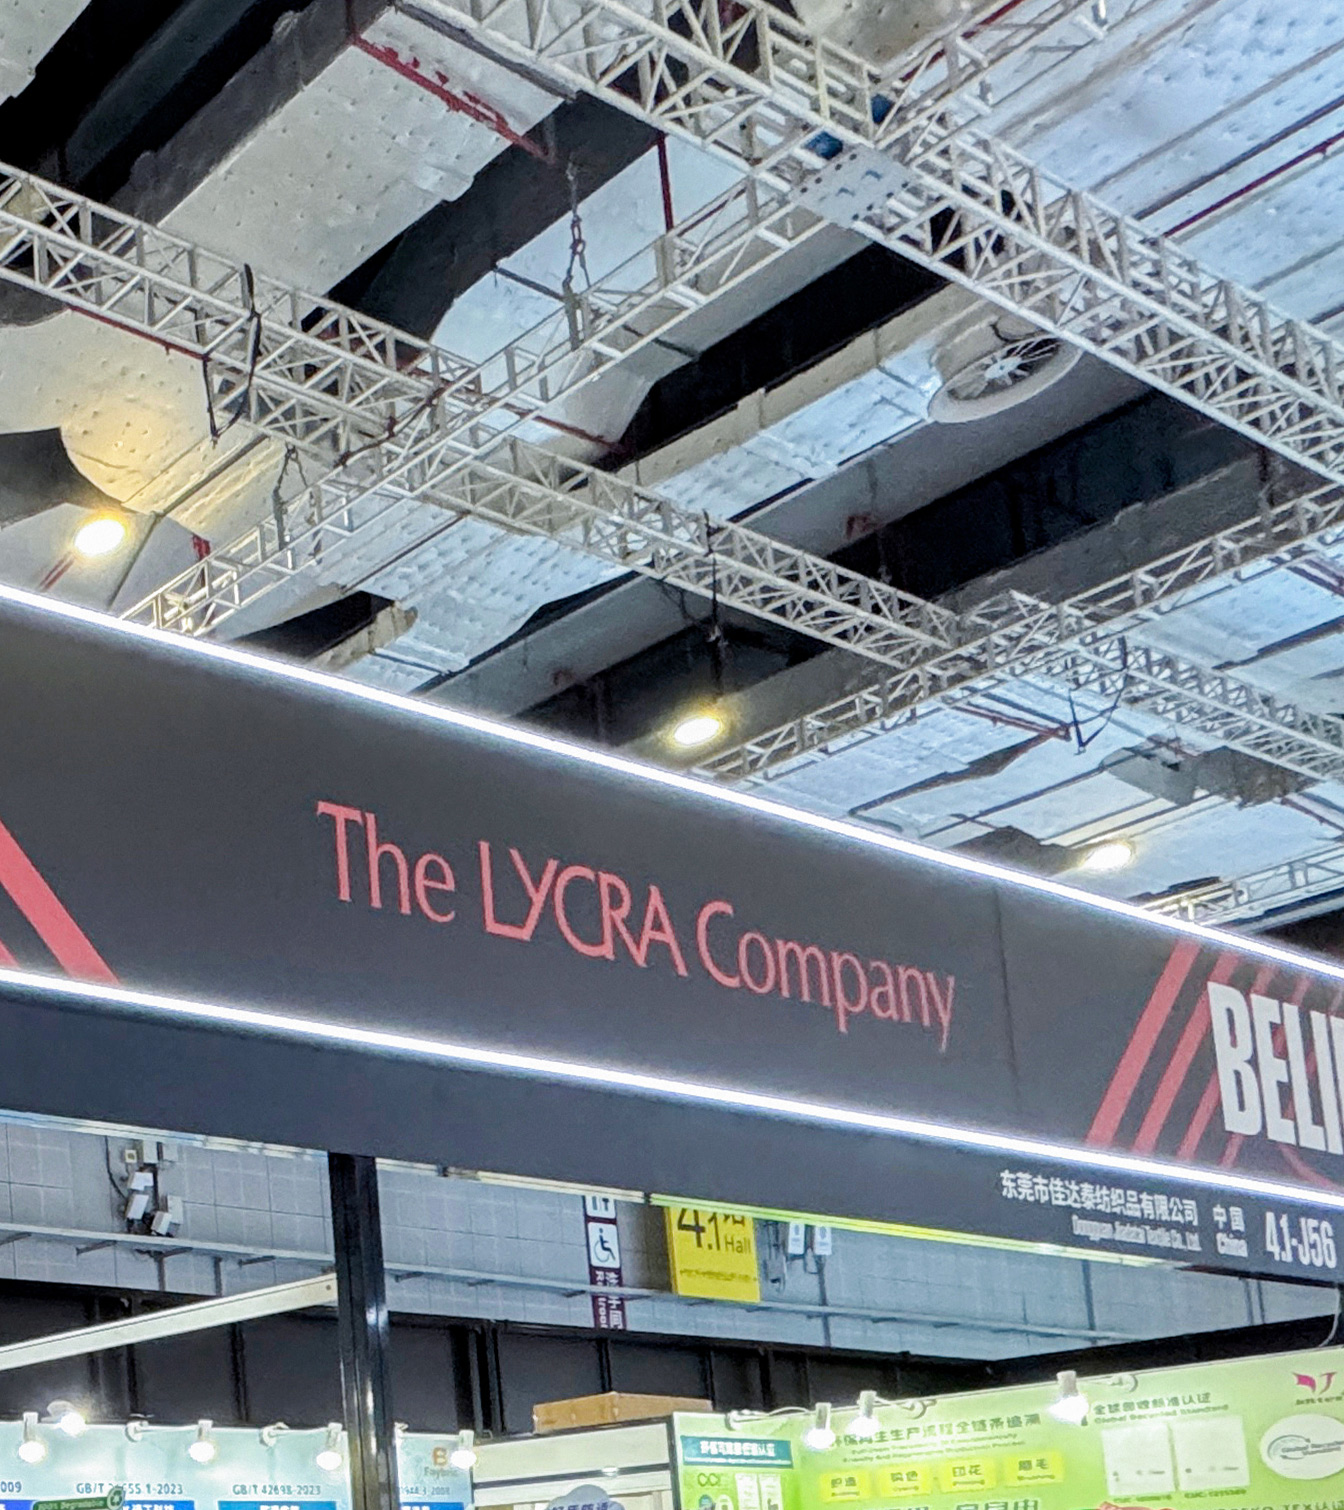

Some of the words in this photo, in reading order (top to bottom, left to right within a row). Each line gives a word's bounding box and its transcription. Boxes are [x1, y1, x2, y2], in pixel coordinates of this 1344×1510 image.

[316, 801, 455, 922] The
[479, 841, 687, 977] LYCRA
[697, 901, 955, 1053] Company
[725, 1236, 751, 1253] Hall
[1266, 1211, 1337, 1269] 4.1-J56
[76, 1482, 104, 1494] GB/T
